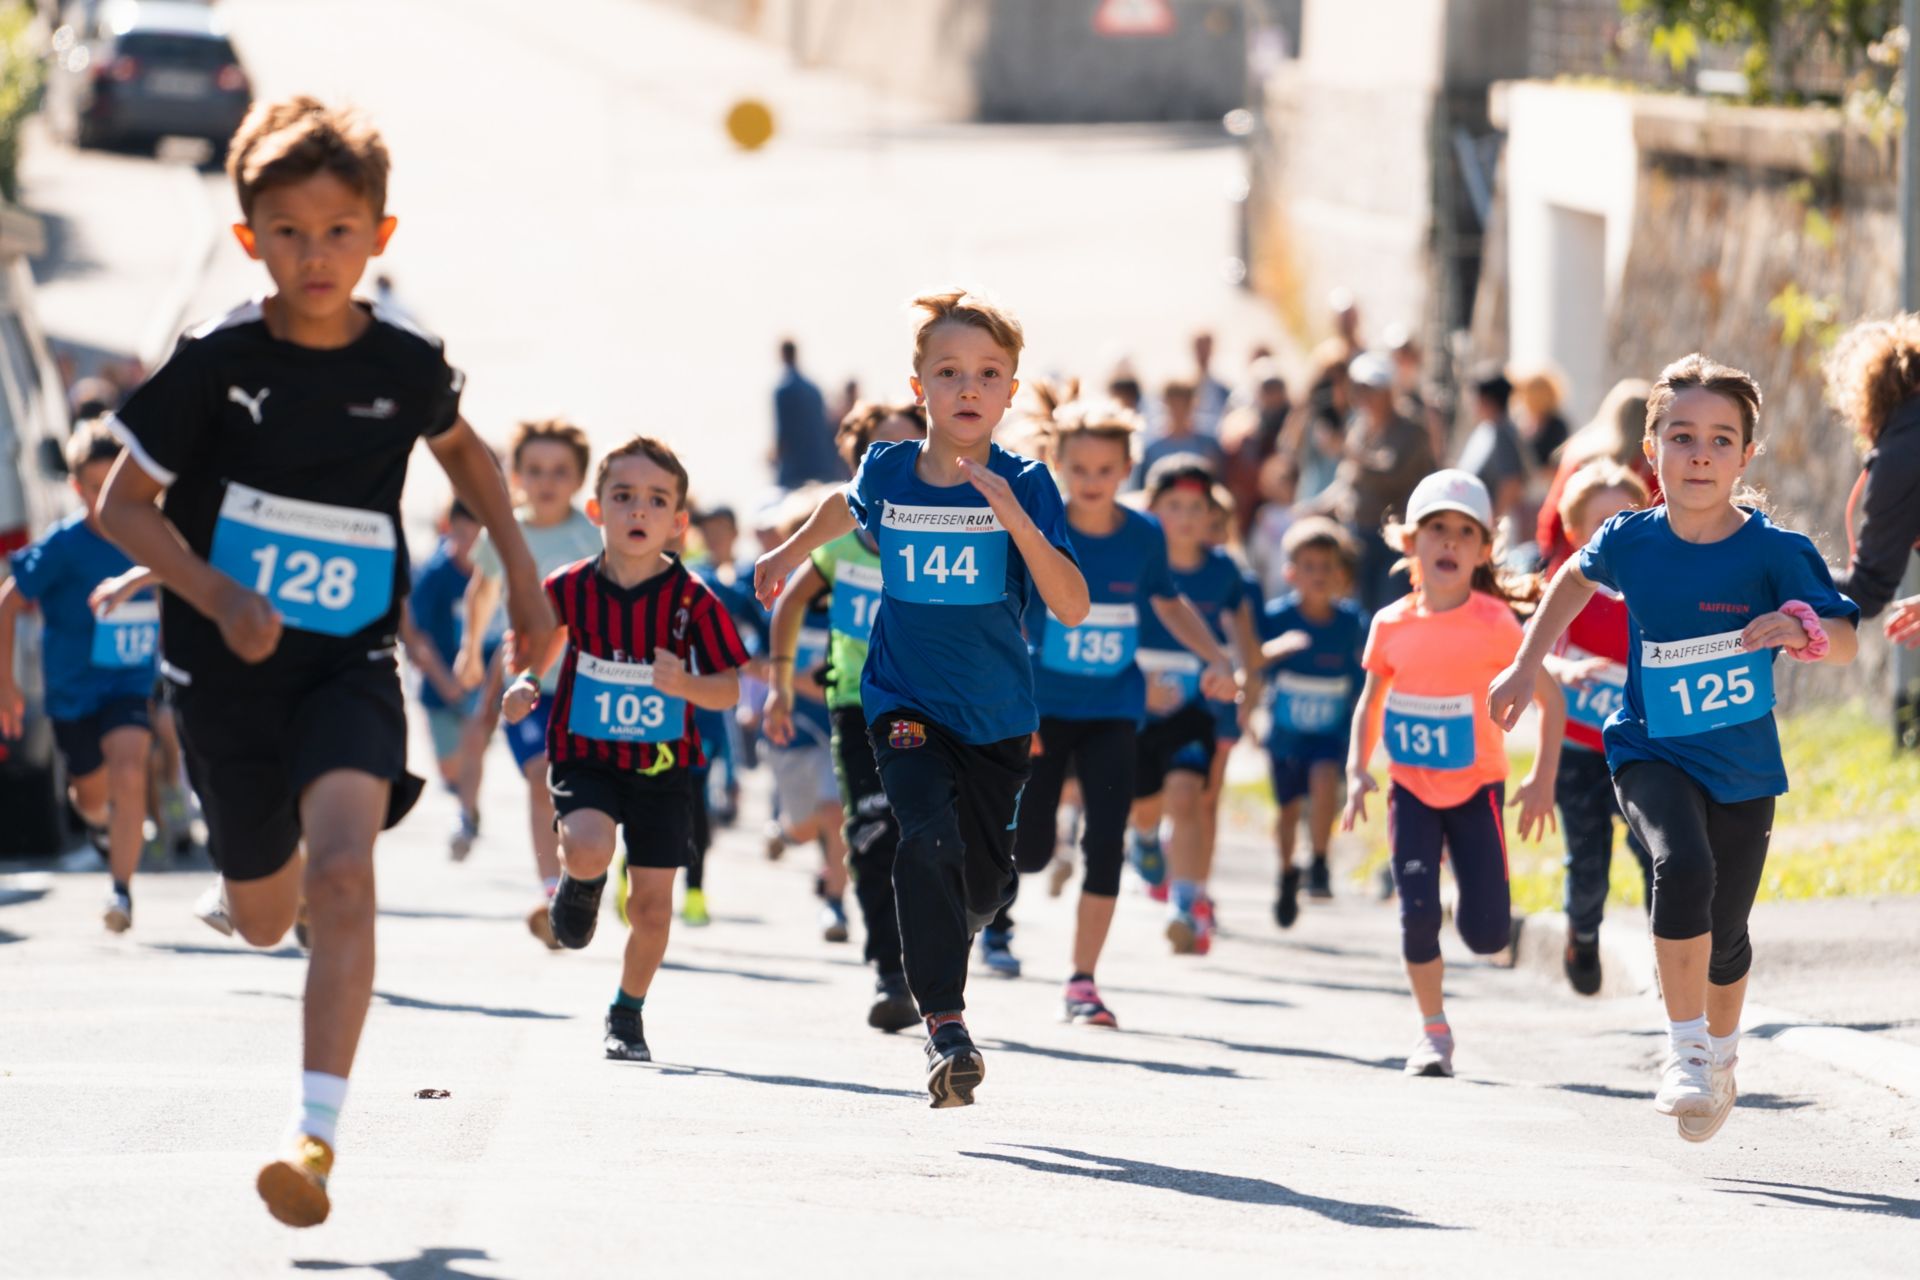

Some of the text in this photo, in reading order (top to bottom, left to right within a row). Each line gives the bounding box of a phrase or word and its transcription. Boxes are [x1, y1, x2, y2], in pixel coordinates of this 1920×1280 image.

[251, 544, 357, 610] 128
[898, 544, 979, 585] 144
[1064, 630, 1124, 664] 135
[594, 691, 665, 729] 103
[1669, 665, 1756, 716] 125
[1394, 721, 1448, 757] 131
